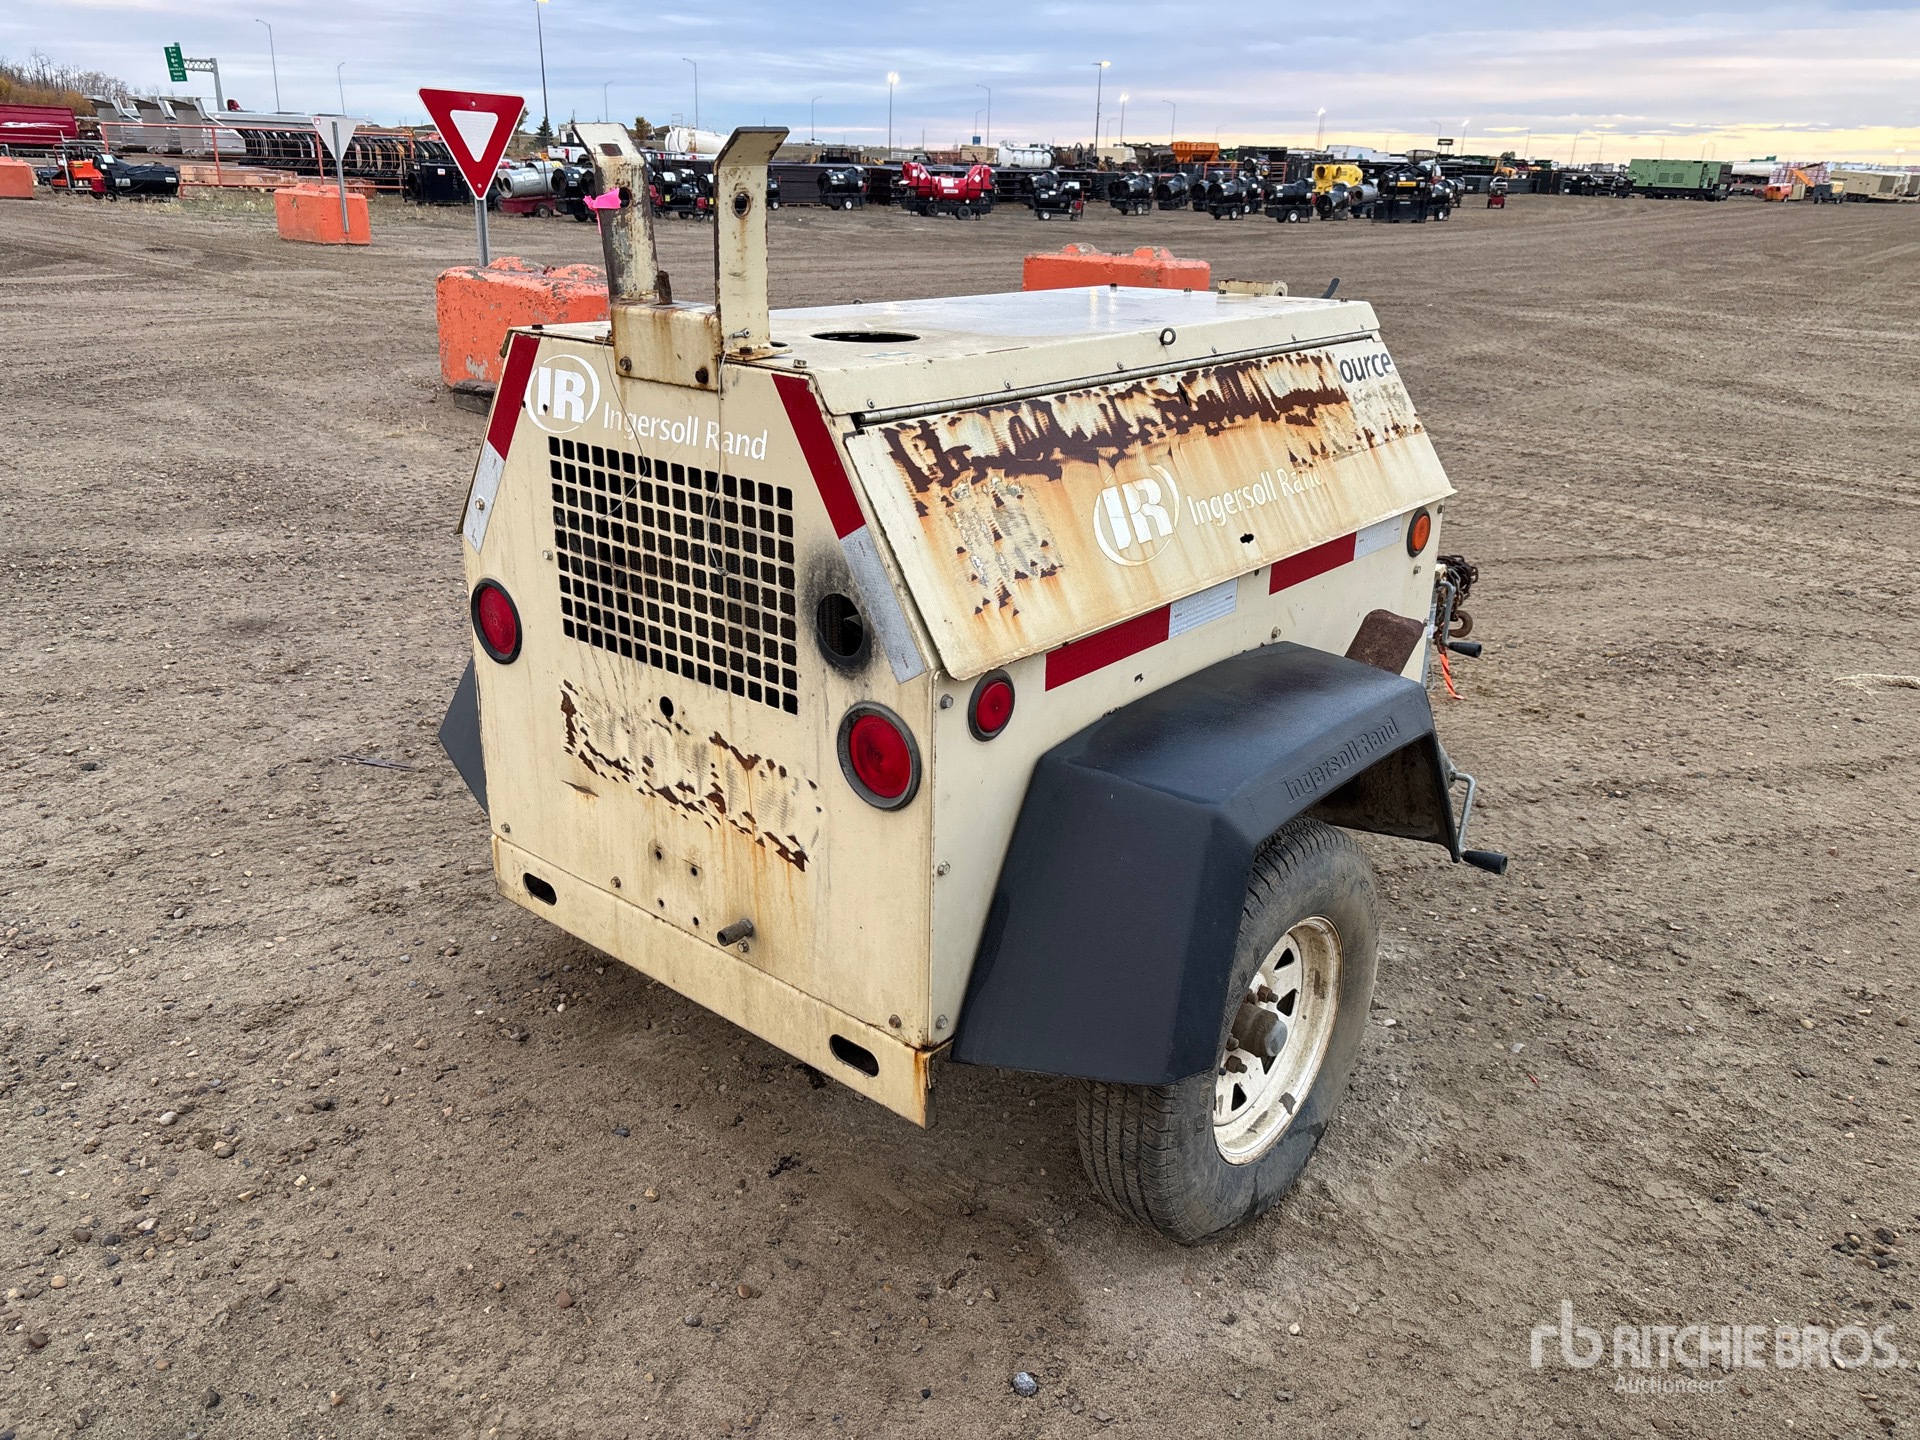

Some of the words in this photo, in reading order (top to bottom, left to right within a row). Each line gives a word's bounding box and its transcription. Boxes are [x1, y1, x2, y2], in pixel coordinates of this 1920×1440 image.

[537, 366, 586, 424] IR
[603, 401, 699, 446] Ingersoll
[705, 419, 769, 461] Rand
[1101, 477, 1174, 551] IR
[1187, 470, 1278, 528] Ingersoll
